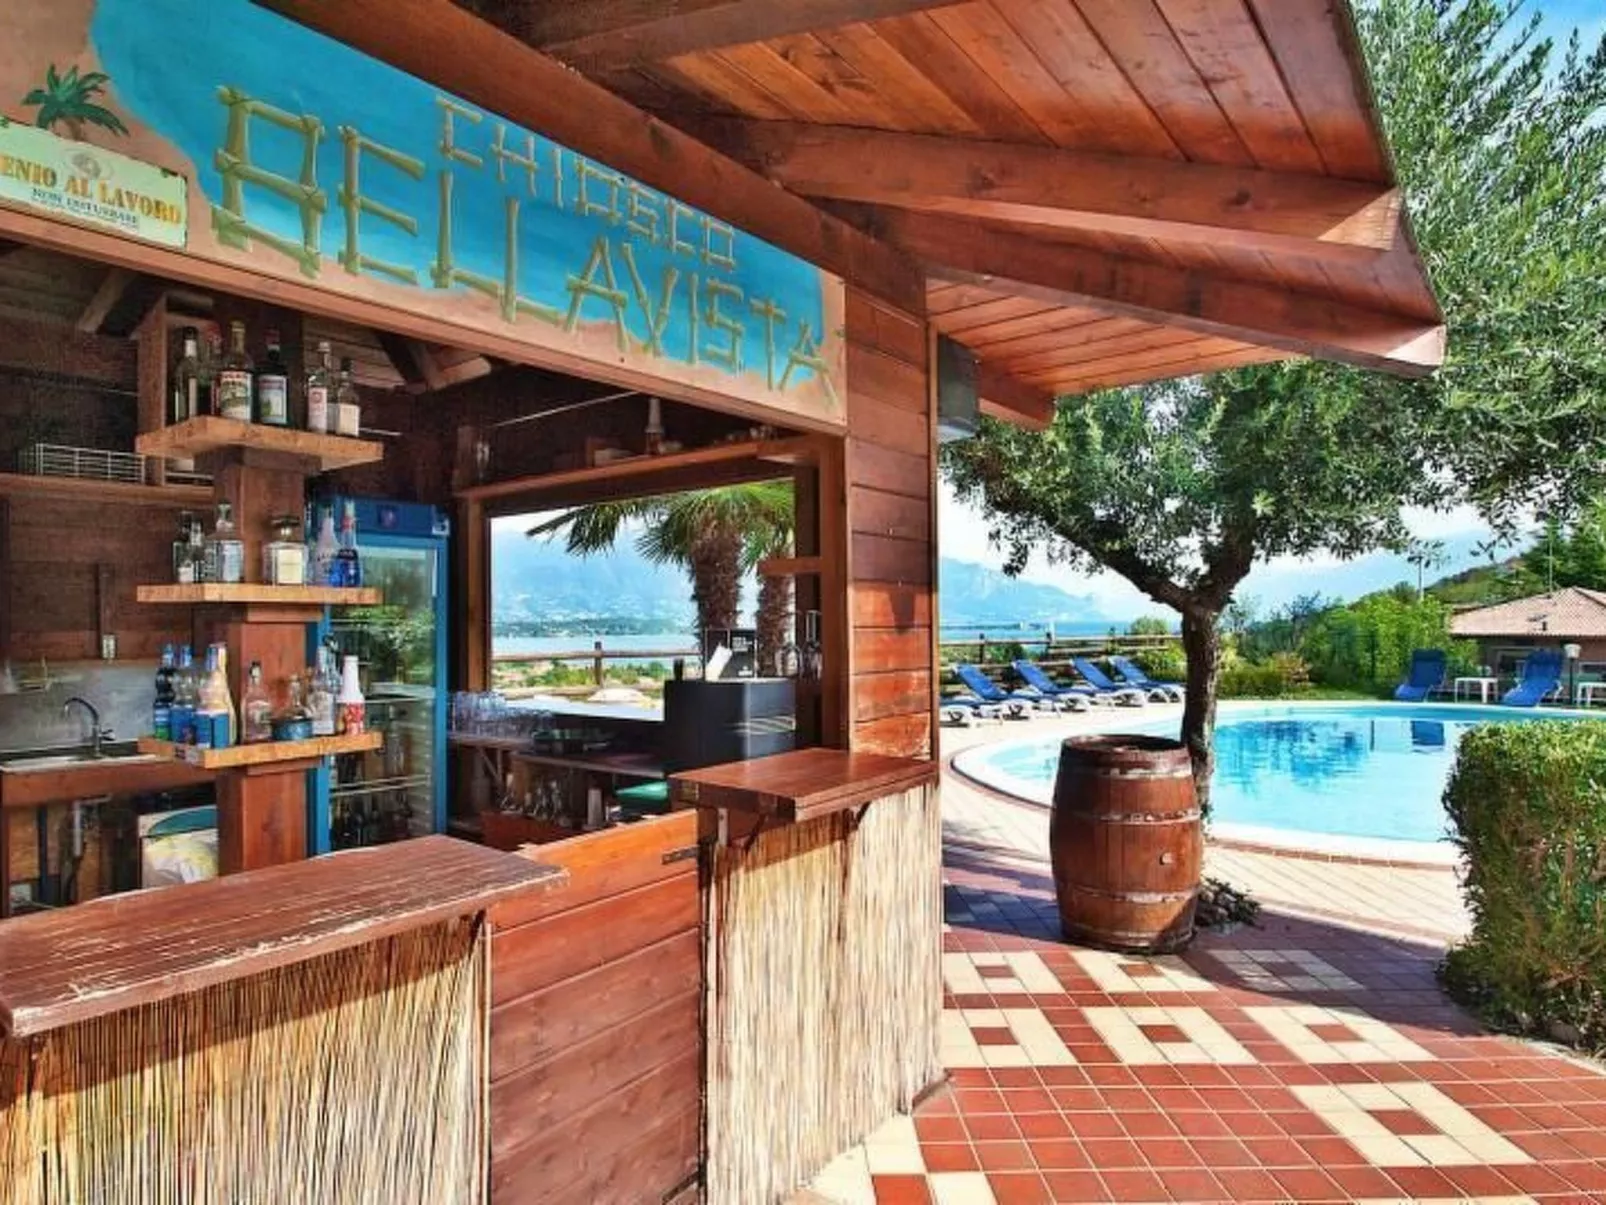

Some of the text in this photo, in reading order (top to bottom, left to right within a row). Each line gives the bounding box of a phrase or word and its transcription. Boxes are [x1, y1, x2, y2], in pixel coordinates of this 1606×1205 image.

[0, 154, 57, 188] ENIO
[64, 175, 93, 199] AL
[98, 179, 181, 224] LAVORO
[211, 85, 839, 411] BELLAVISTA
[436, 95, 736, 271] CHIOSCO
